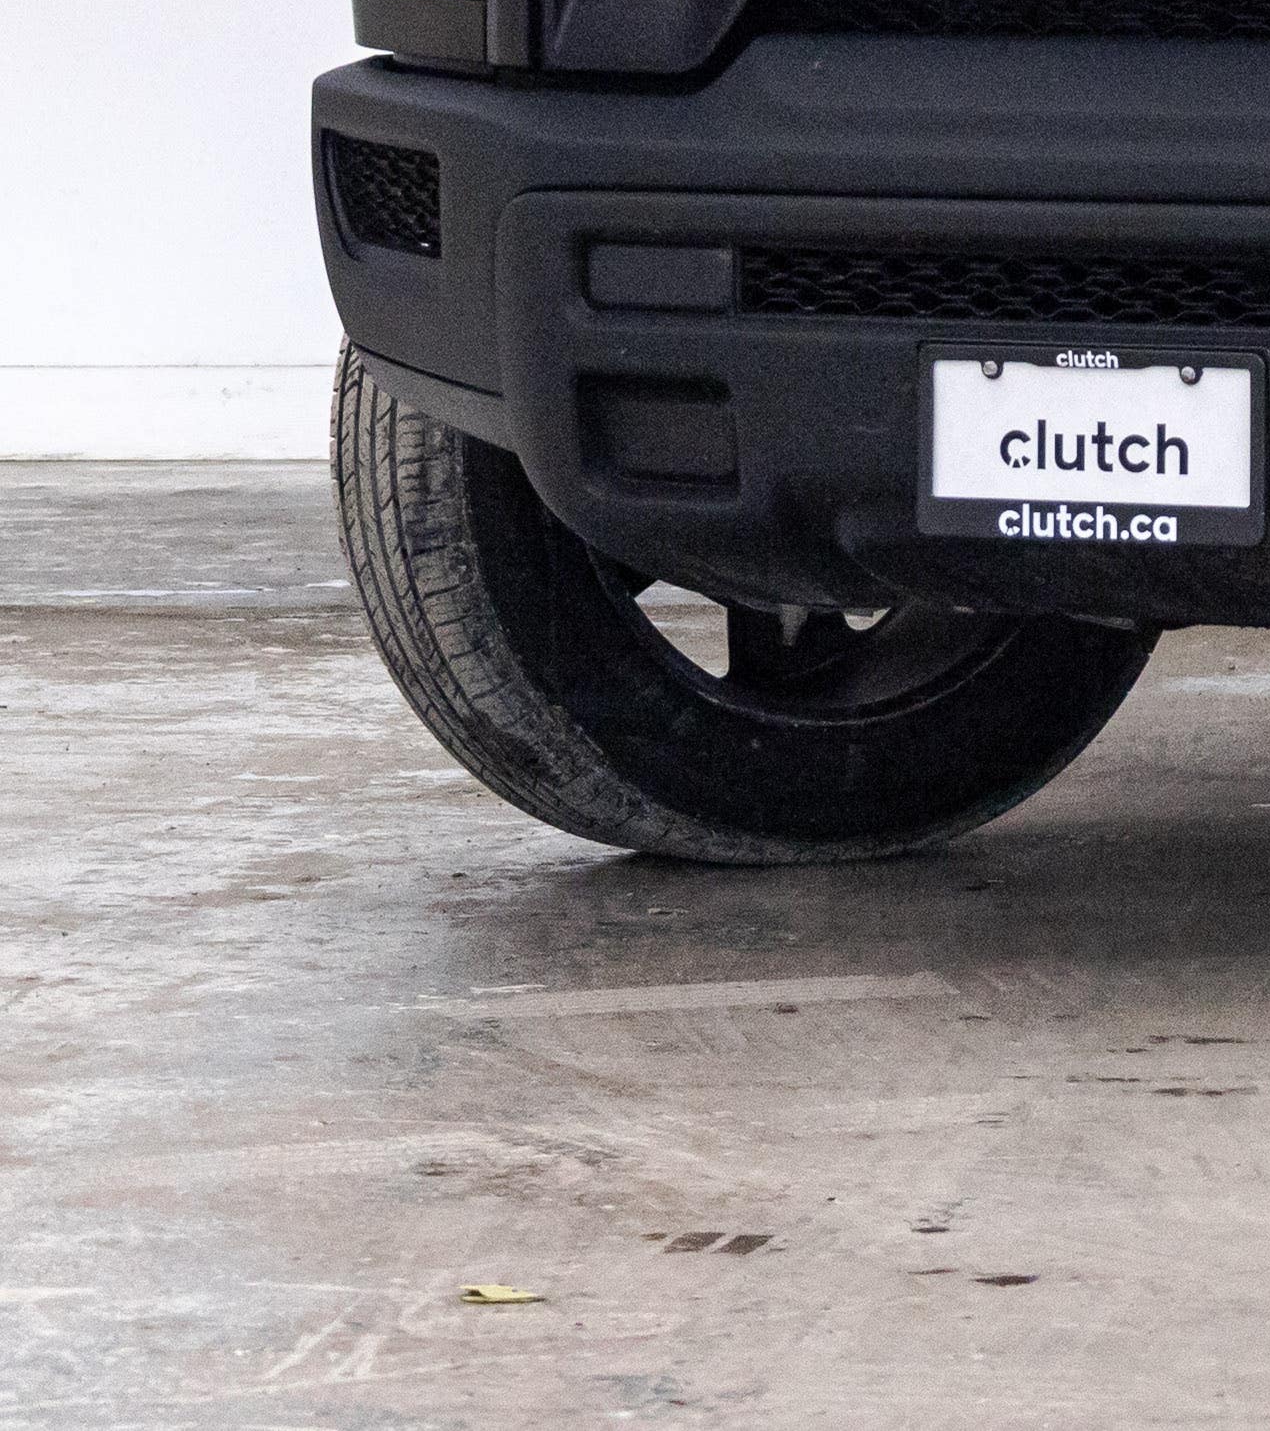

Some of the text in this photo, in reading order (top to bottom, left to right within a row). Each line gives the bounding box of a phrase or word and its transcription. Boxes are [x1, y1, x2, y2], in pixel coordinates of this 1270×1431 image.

[1056, 350, 1119, 369] clutch
[999, 419, 1189, 475] clutch
[998, 503, 1178, 542] clutch.ca
